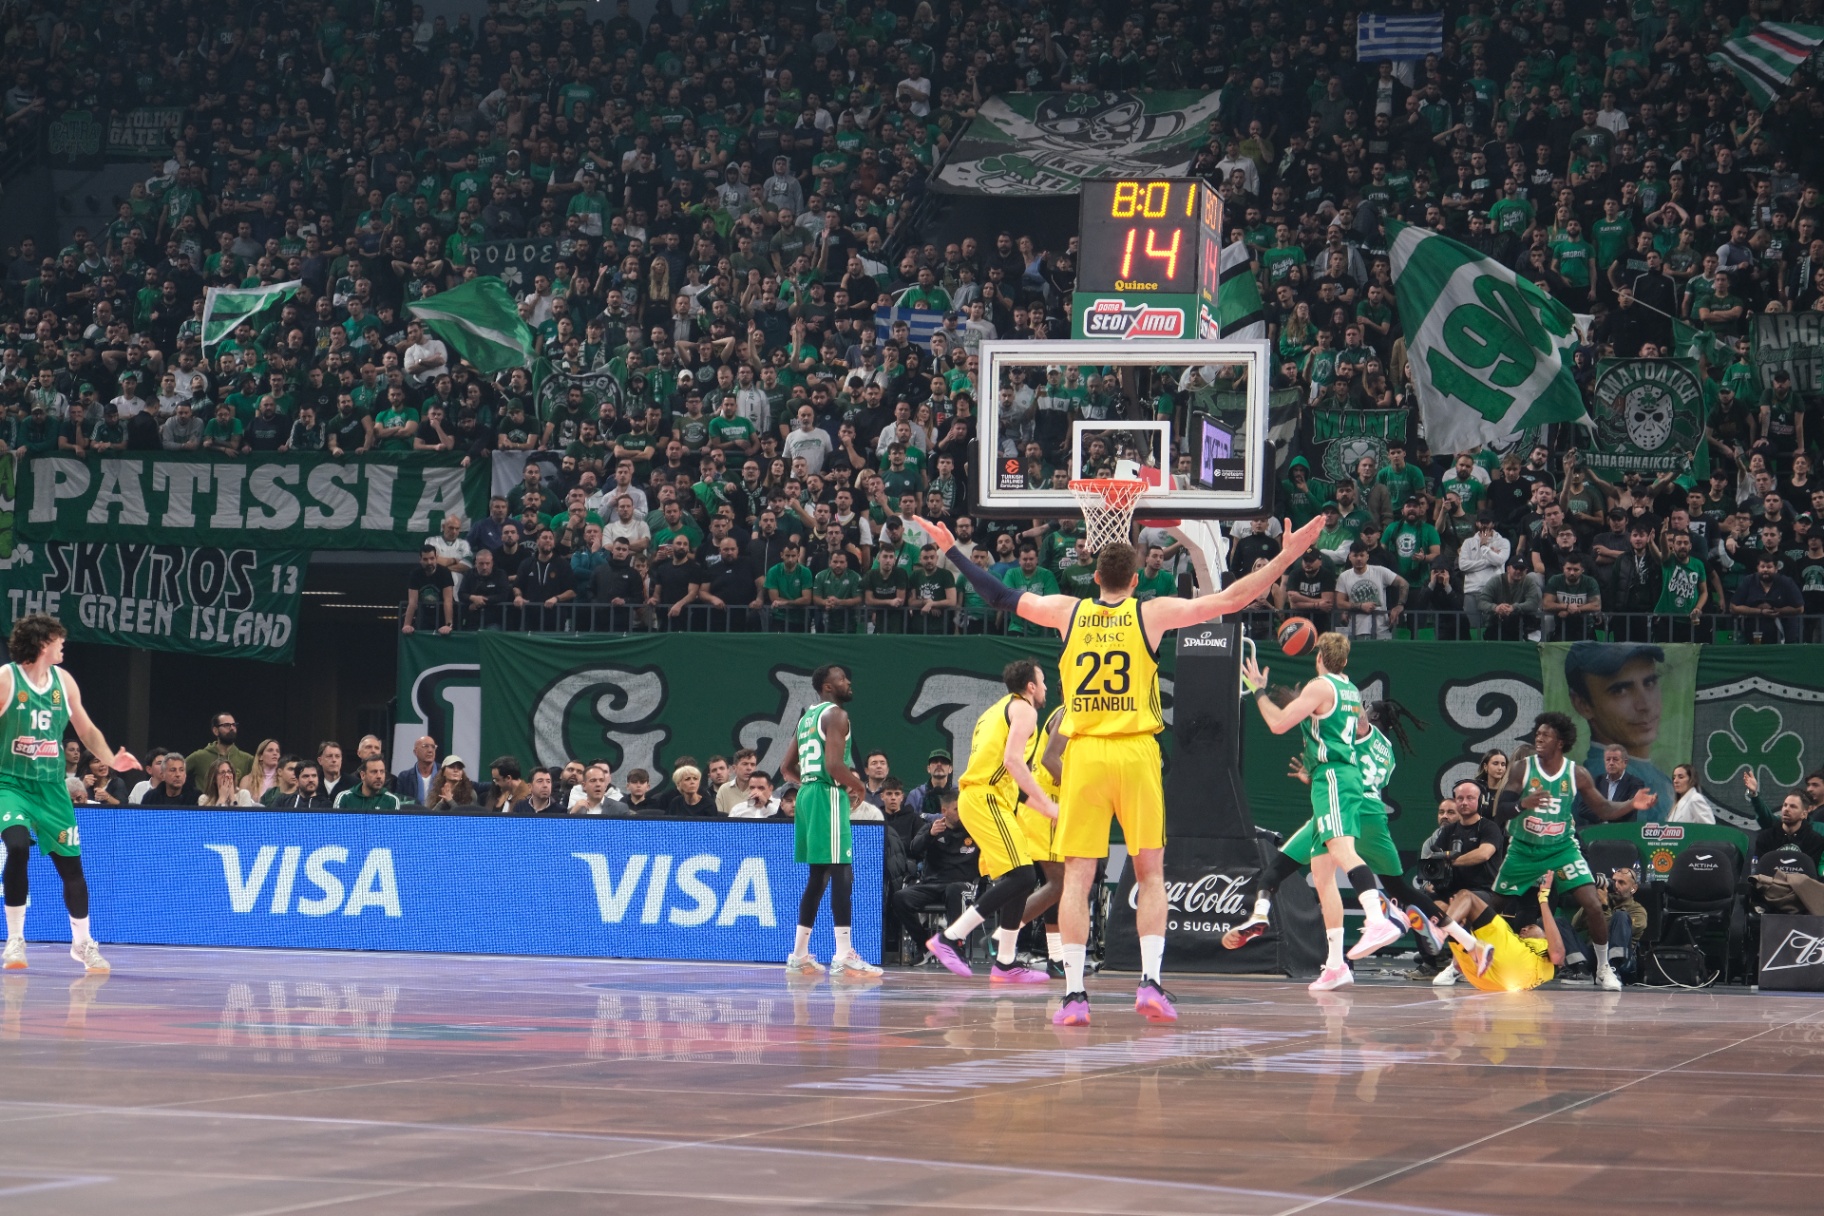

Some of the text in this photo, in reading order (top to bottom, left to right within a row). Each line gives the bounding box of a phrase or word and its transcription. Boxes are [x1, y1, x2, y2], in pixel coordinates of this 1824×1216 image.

[110, 128, 158, 145] GATE
[1111, 181, 1197, 219] 8:01
[1120, 227, 1182, 281] 14
[1114, 280, 1158, 291] Quince
[1758, 314, 1824, 350] ARG
[28, 457, 472, 532] PATISSIA
[43, 542, 298, 612] SKYROS 13
[8, 589, 292, 648] THE GREEN ISLAND
[1096, 632, 1125, 643] MSC
[1183, 637, 1227, 648] SPALDING
[1075, 650, 1131, 696] 23
[30, 710, 52, 730] 16
[798, 739, 822, 775] 22
[1317, 814, 1334, 834] 41
[203, 844, 402, 917] VISA
[1563, 860, 1589, 880] 25
[571, 852, 777, 928] VISA
[1183, 920, 1231, 932] SUGAR
